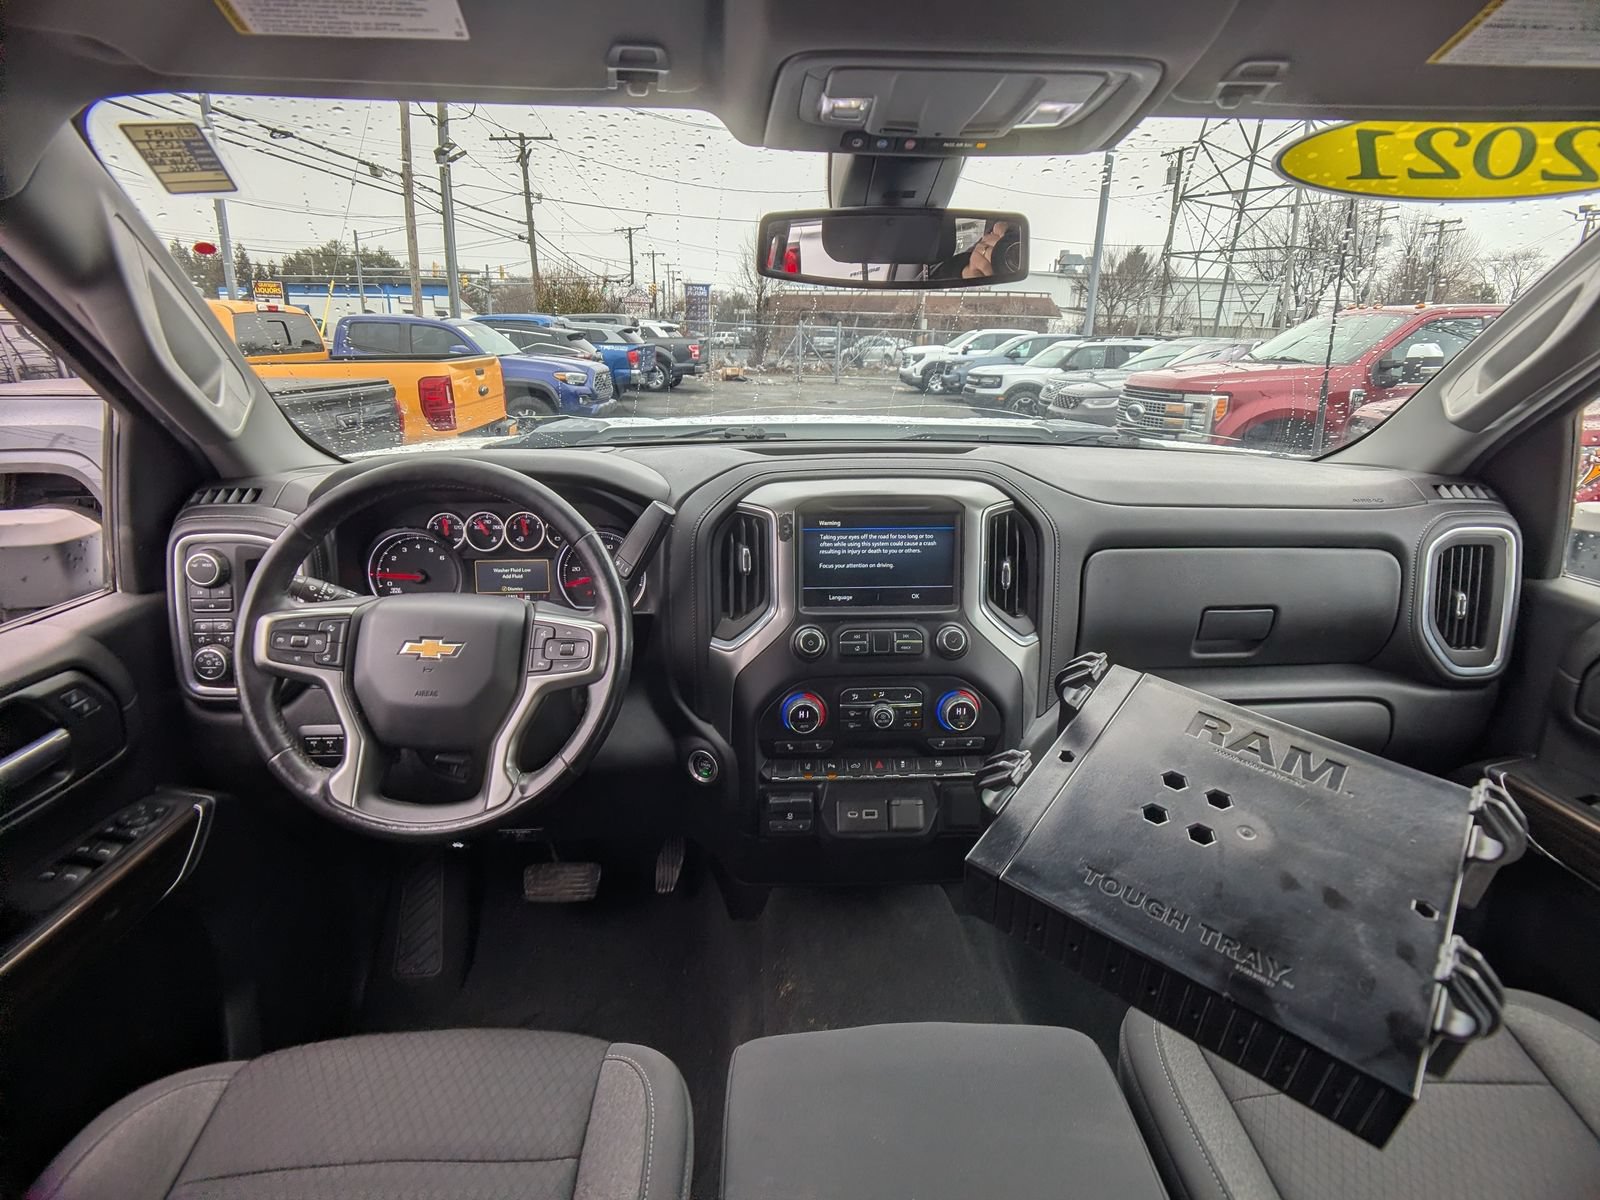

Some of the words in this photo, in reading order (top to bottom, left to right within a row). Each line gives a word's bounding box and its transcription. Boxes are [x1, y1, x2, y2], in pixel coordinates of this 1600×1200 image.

[1184, 710, 1350, 794] RAM
[1084, 866, 1192, 934] TOUGH
[1198, 922, 1293, 982] TRAY
